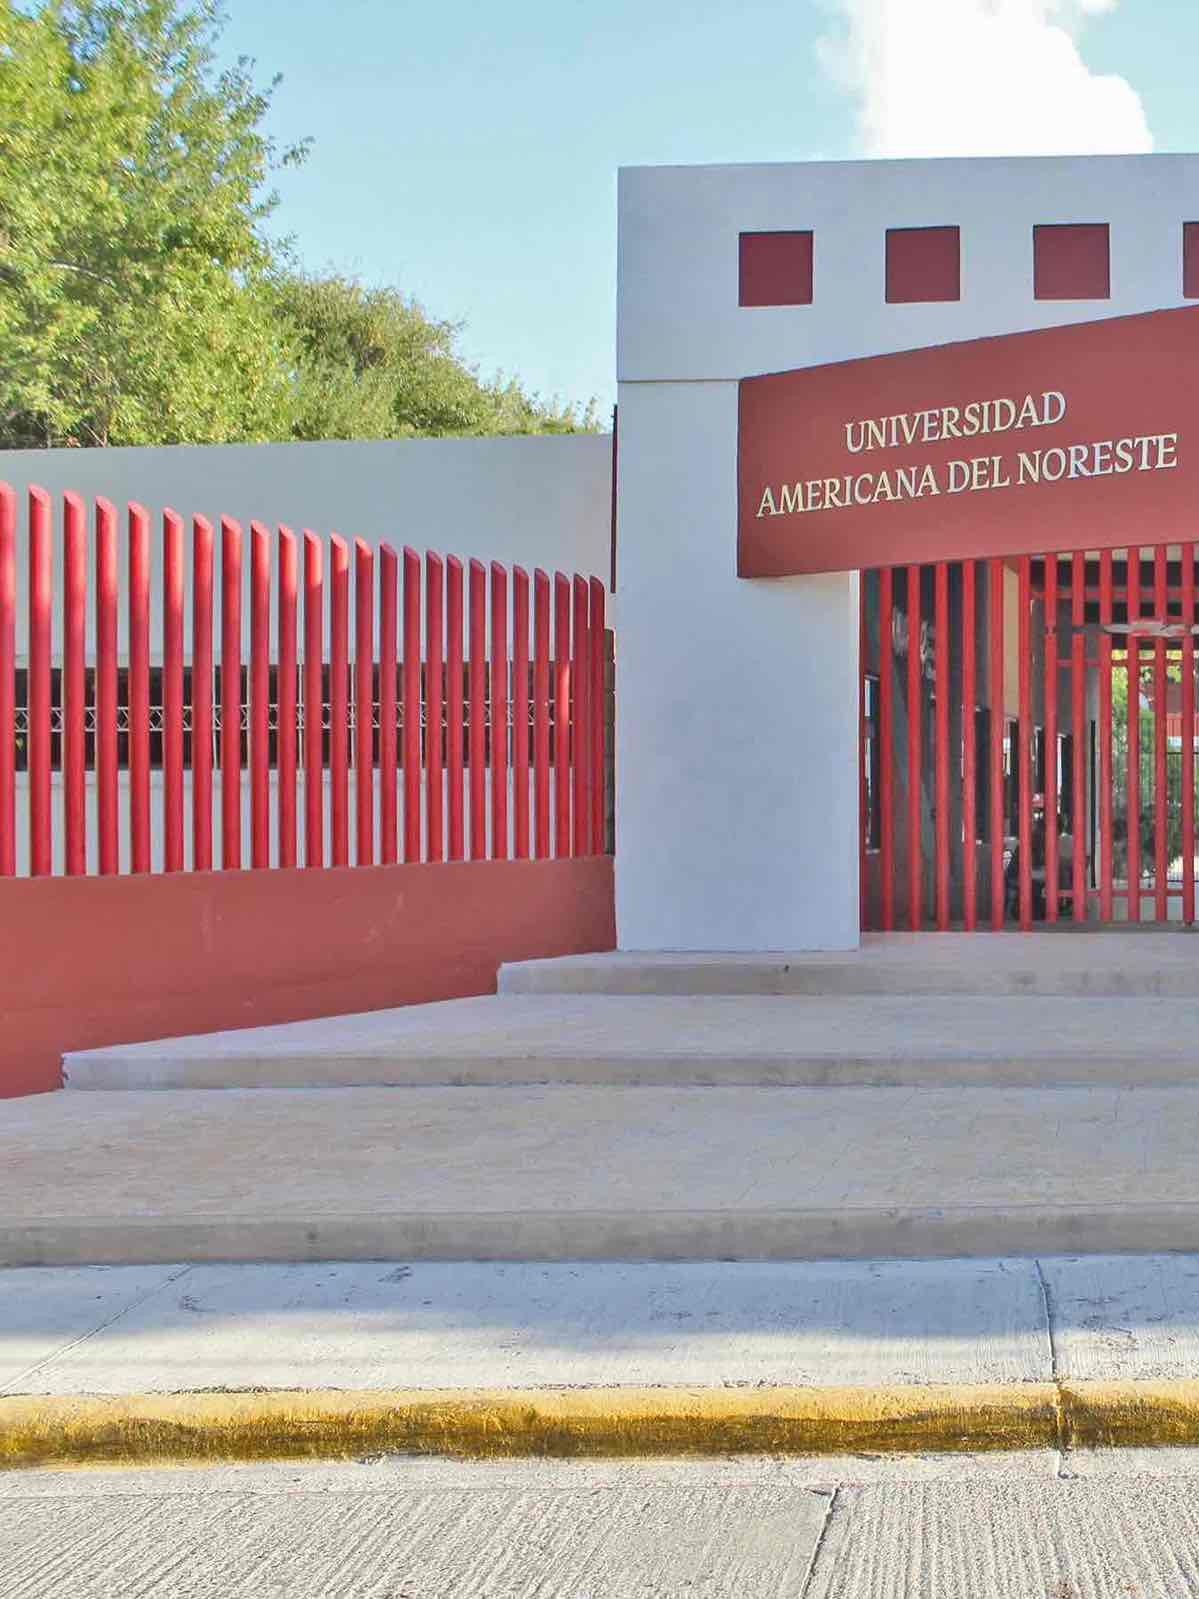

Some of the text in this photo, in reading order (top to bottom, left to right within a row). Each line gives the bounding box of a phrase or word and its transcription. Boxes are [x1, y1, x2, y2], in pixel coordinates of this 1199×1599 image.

[844, 391, 1066, 453] UNIVERSIDAD
[756, 433, 1178, 517] AMERICANA DEL NORESTE
